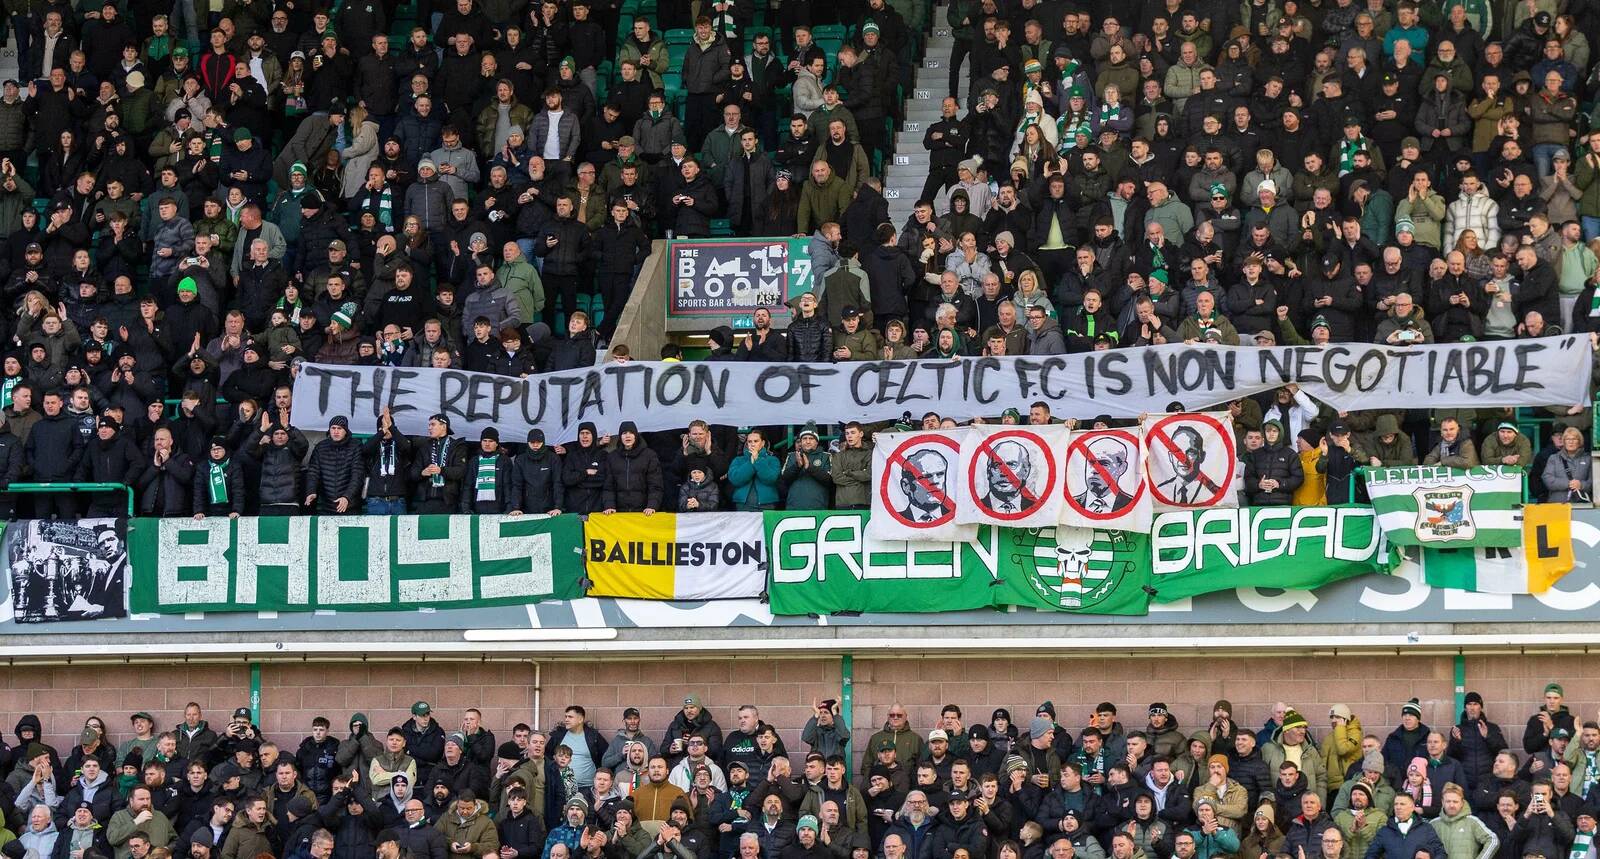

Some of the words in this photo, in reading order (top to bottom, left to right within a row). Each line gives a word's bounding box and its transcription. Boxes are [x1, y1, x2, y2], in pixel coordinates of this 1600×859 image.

[887, 190, 899, 198] KK
[678, 278, 779, 297] ROOM
[678, 299, 707, 307] SPORTS
[709, 299, 725, 307] BAR
[726, 299, 732, 307] &
[440, 364, 730, 430] REPUTATION
[754, 364, 840, 405] OF
[850, 360, 1000, 406] CELTIC
[1014, 357, 1067, 400] F.C
[1084, 352, 1133, 399] IS
[1142, 349, 1236, 397] NON
[1367, 465, 1455, 487] LEITH
[590, 538, 763, 566] BAILLIESTON
[1152, 507, 1389, 574] BRIGAD
[158, 513, 554, 605] BHOYS
